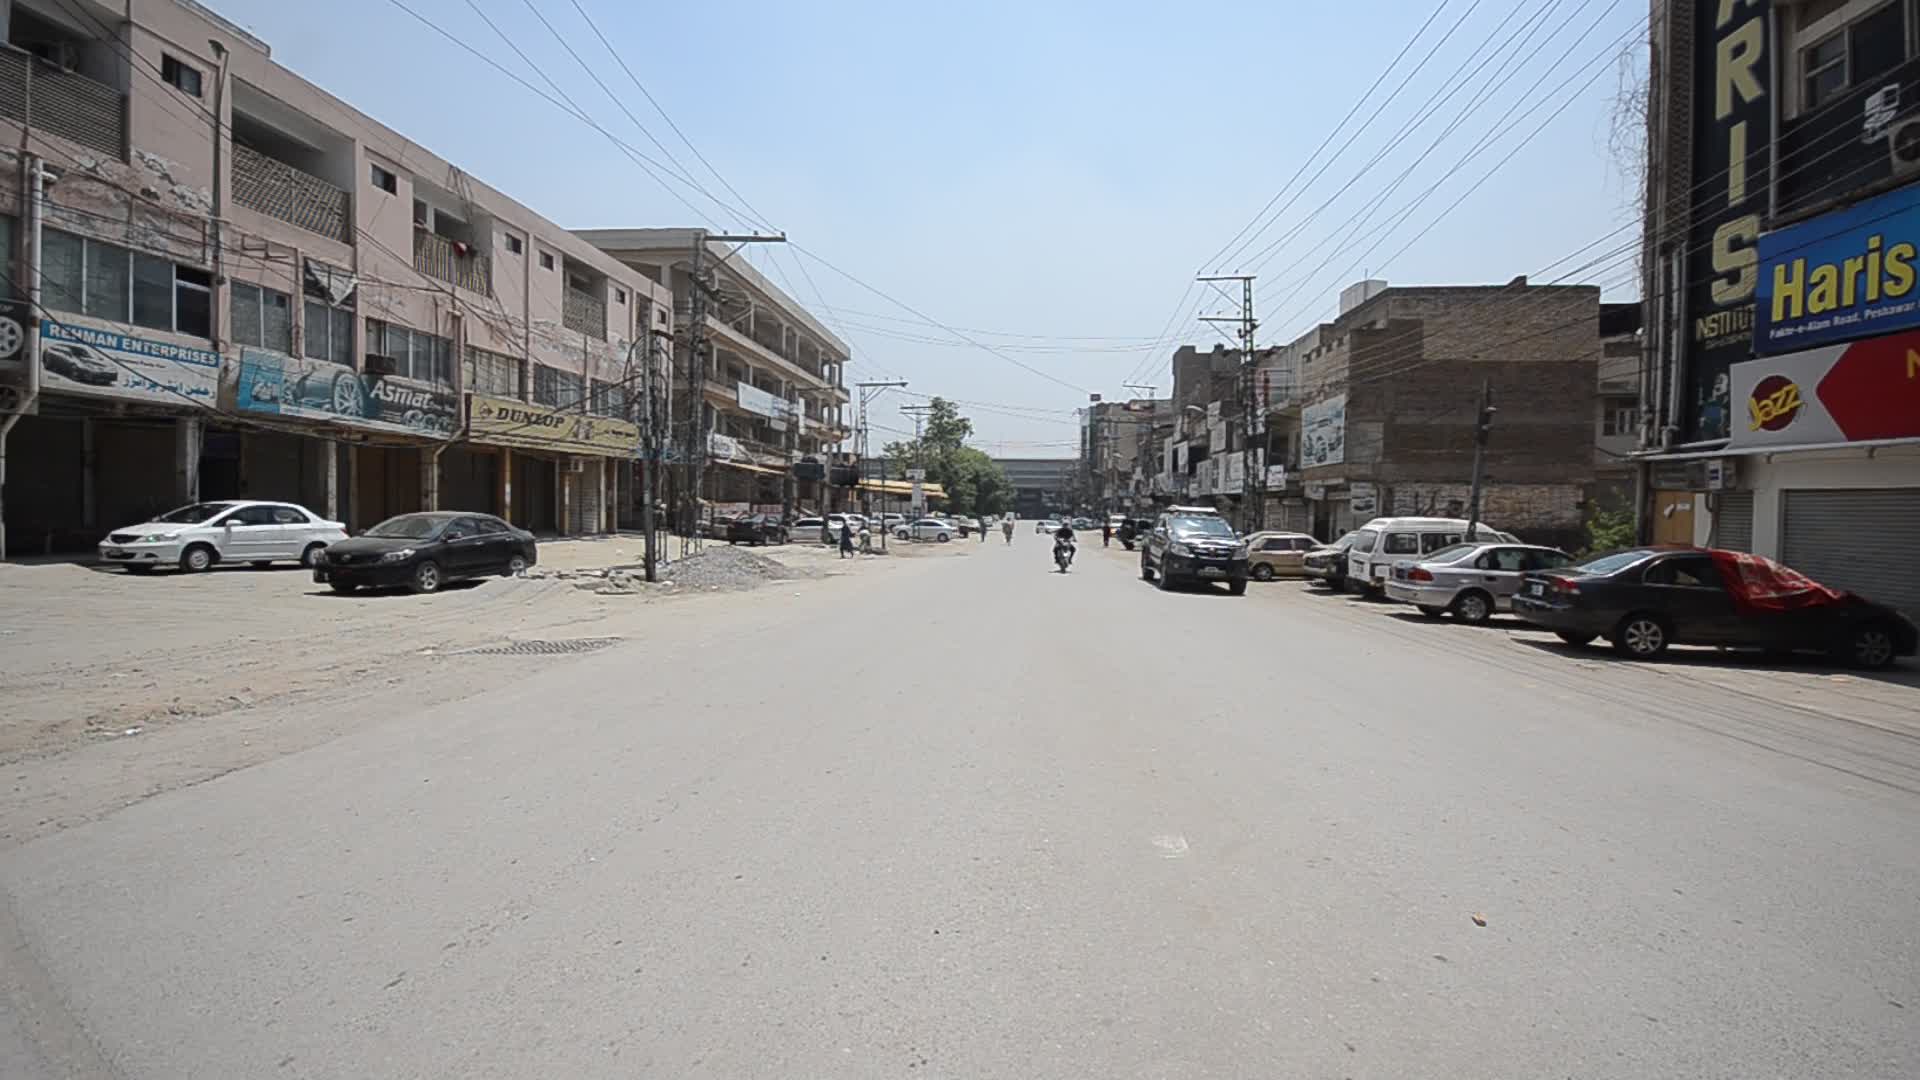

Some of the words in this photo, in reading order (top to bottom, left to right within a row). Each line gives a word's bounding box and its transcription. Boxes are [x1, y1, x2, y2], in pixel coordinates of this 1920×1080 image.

[1771, 235, 1916, 322] Haris
[49, 323, 118, 348] REHMAN
[121, 338, 218, 365] ENTERPRISES
[369, 379, 433, 409] Asmat
[1748, 382, 1806, 432] Jazz
[496, 406, 565, 429] DUNLOP
